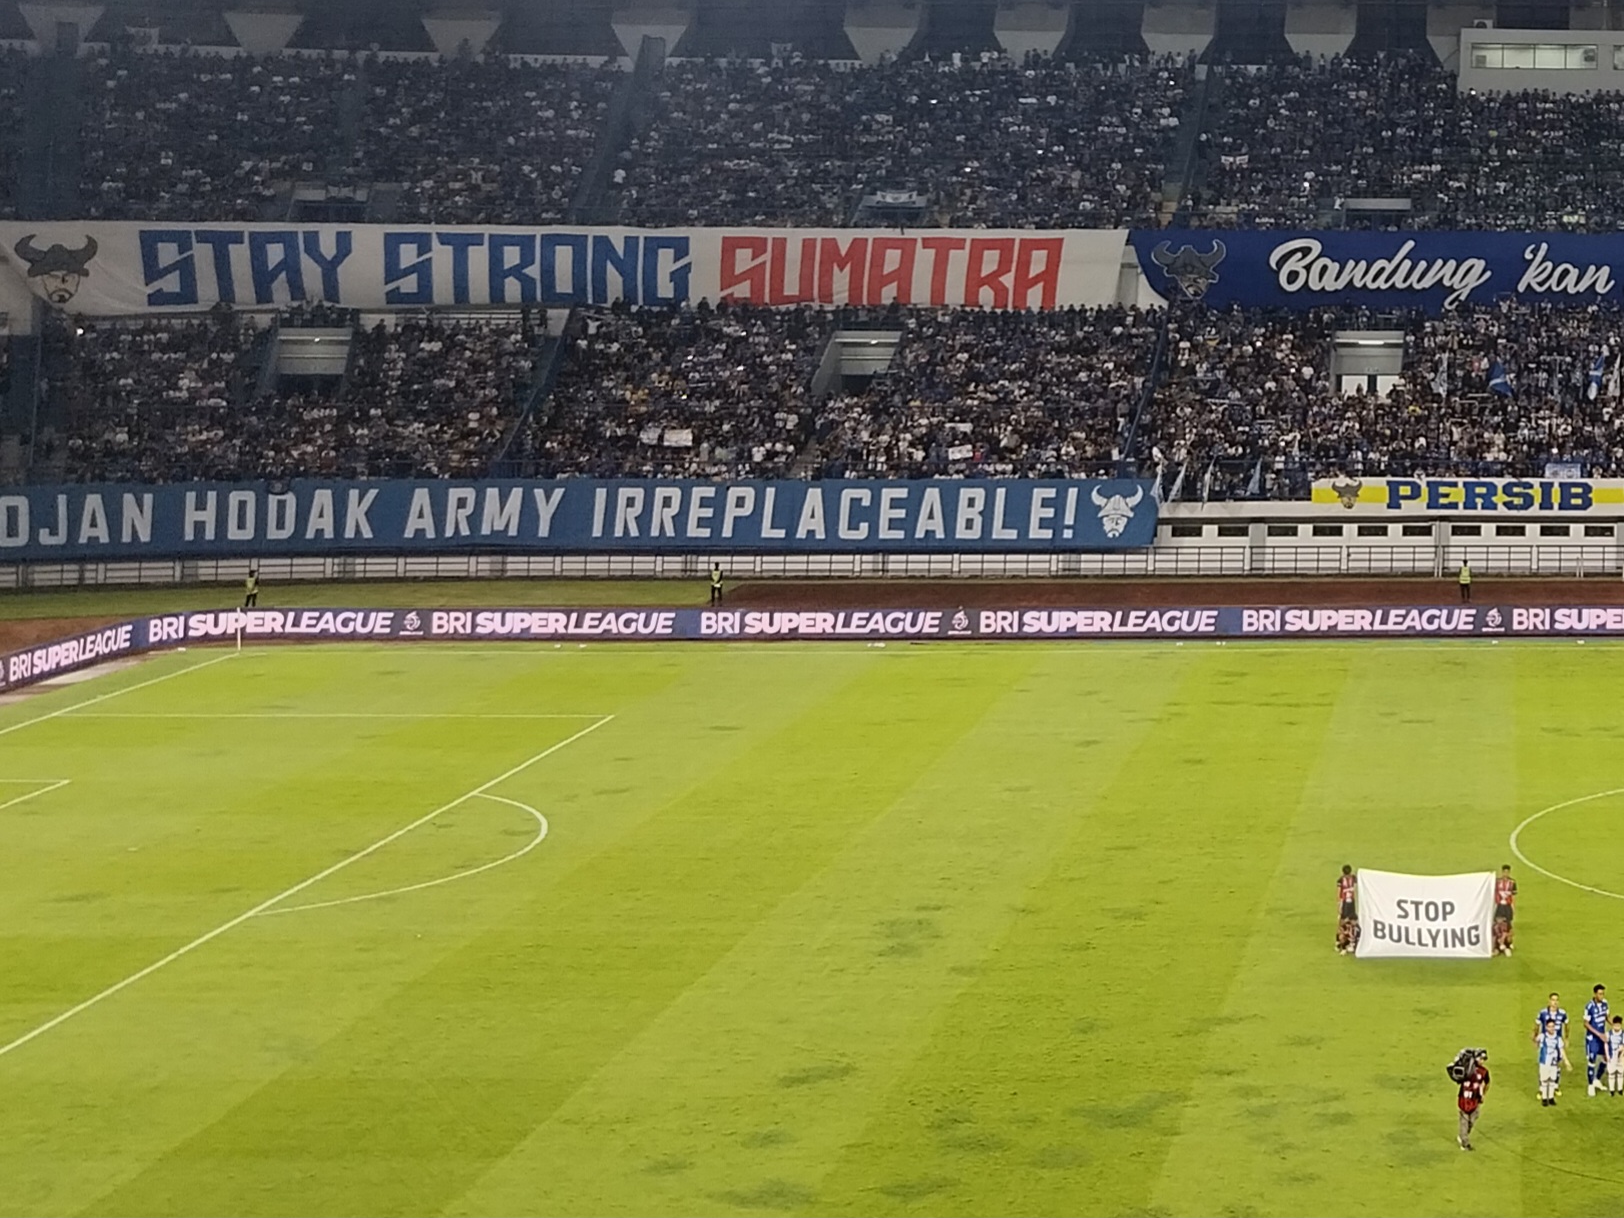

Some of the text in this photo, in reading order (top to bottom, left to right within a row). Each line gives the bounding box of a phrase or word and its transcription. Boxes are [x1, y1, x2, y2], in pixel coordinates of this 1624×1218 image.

[139, 230, 1065, 310] STAY STRONG SUMATRA
[1269, 238, 1492, 309] Bandung
[1386, 481, 1594, 512] PERSIB
[184, 488, 379, 540] HODAK
[404, 488, 565, 539] ARMY
[592, 487, 1077, 539] IRREPLACEABLE!
[149, 615, 184, 643] BRI
[432, 611, 472, 634] BRI
[701, 612, 740, 634] BRI
[980, 611, 1019, 634] BRI
[1243, 610, 1281, 632] BRI
[1513, 609, 1550, 631] BRI
[9, 654, 32, 682] BRI
[1396, 899, 1456, 923] STOP
[1372, 920, 1481, 949] BULLYING
